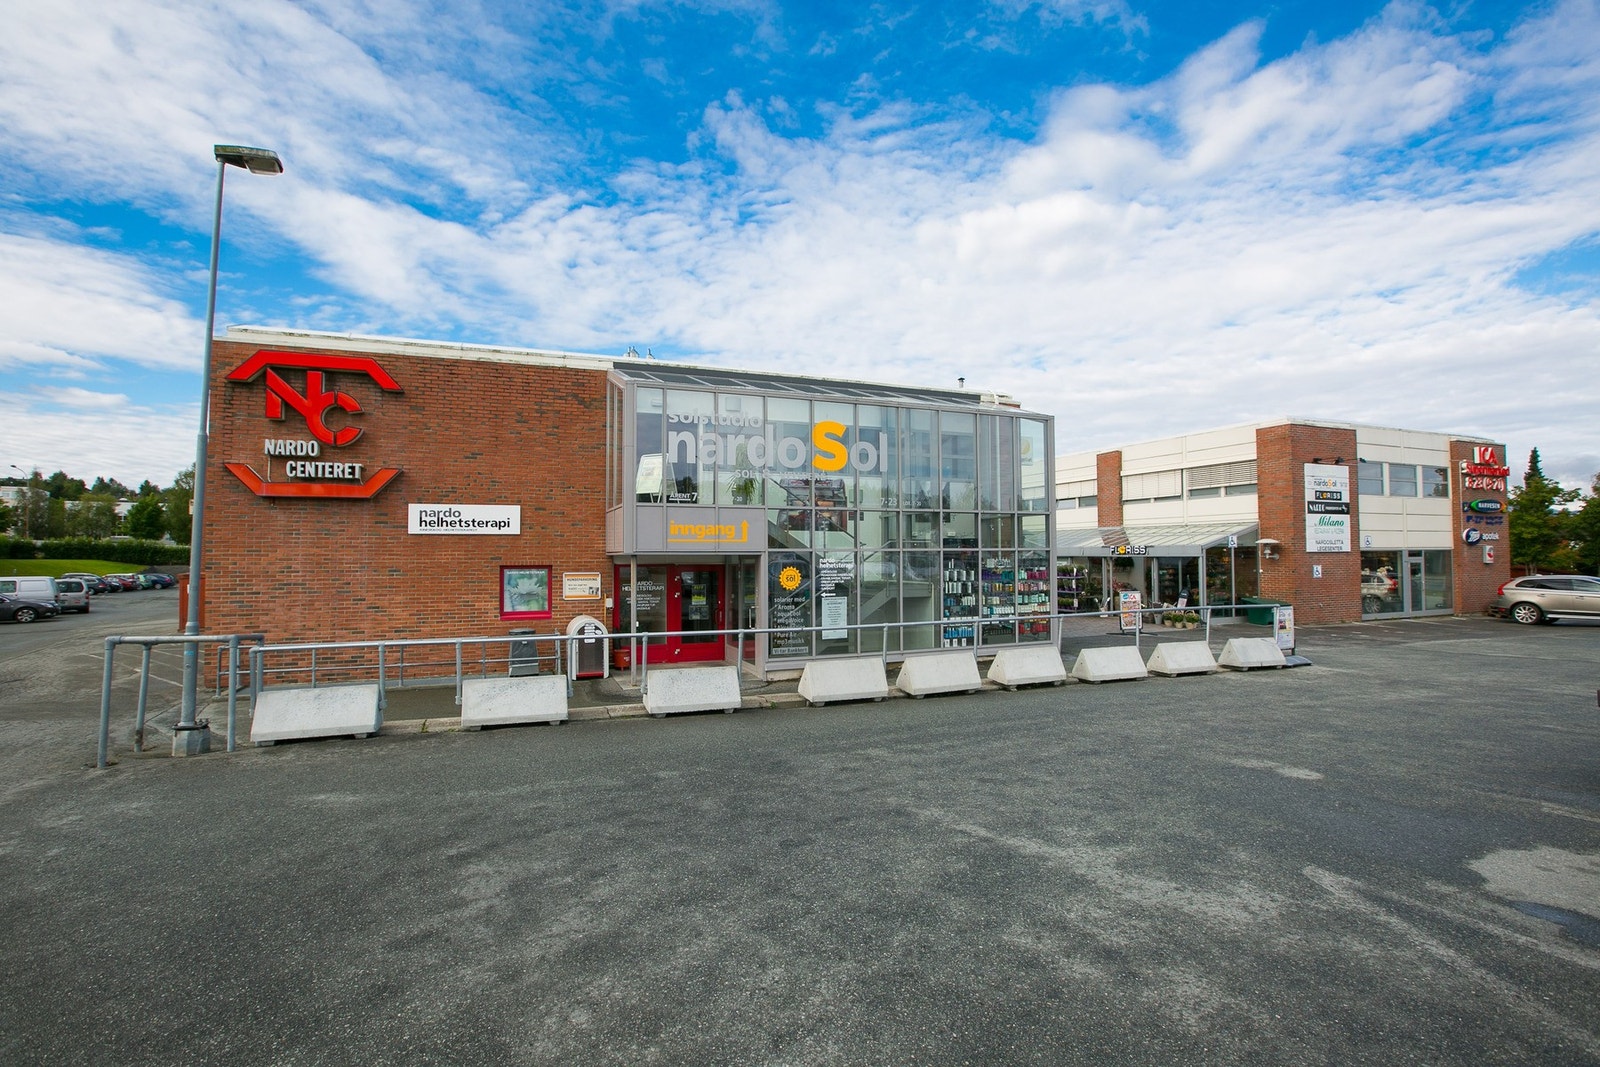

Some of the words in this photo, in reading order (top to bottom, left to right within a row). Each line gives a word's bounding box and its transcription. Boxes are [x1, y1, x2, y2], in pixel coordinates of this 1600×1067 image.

[264, 438, 320, 457] NARDO
[668, 420, 888, 473] nardoSol
[1474, 446, 1498, 464] ICA
[286, 460, 364, 480] CENTERET
[419, 507, 462, 518] nardo
[1318, 515, 1344, 527] Milano
[419, 517, 510, 530] helhetsterapi
[669, 519, 736, 539] inngang
[1110, 545, 1146, 554] FLORISS
